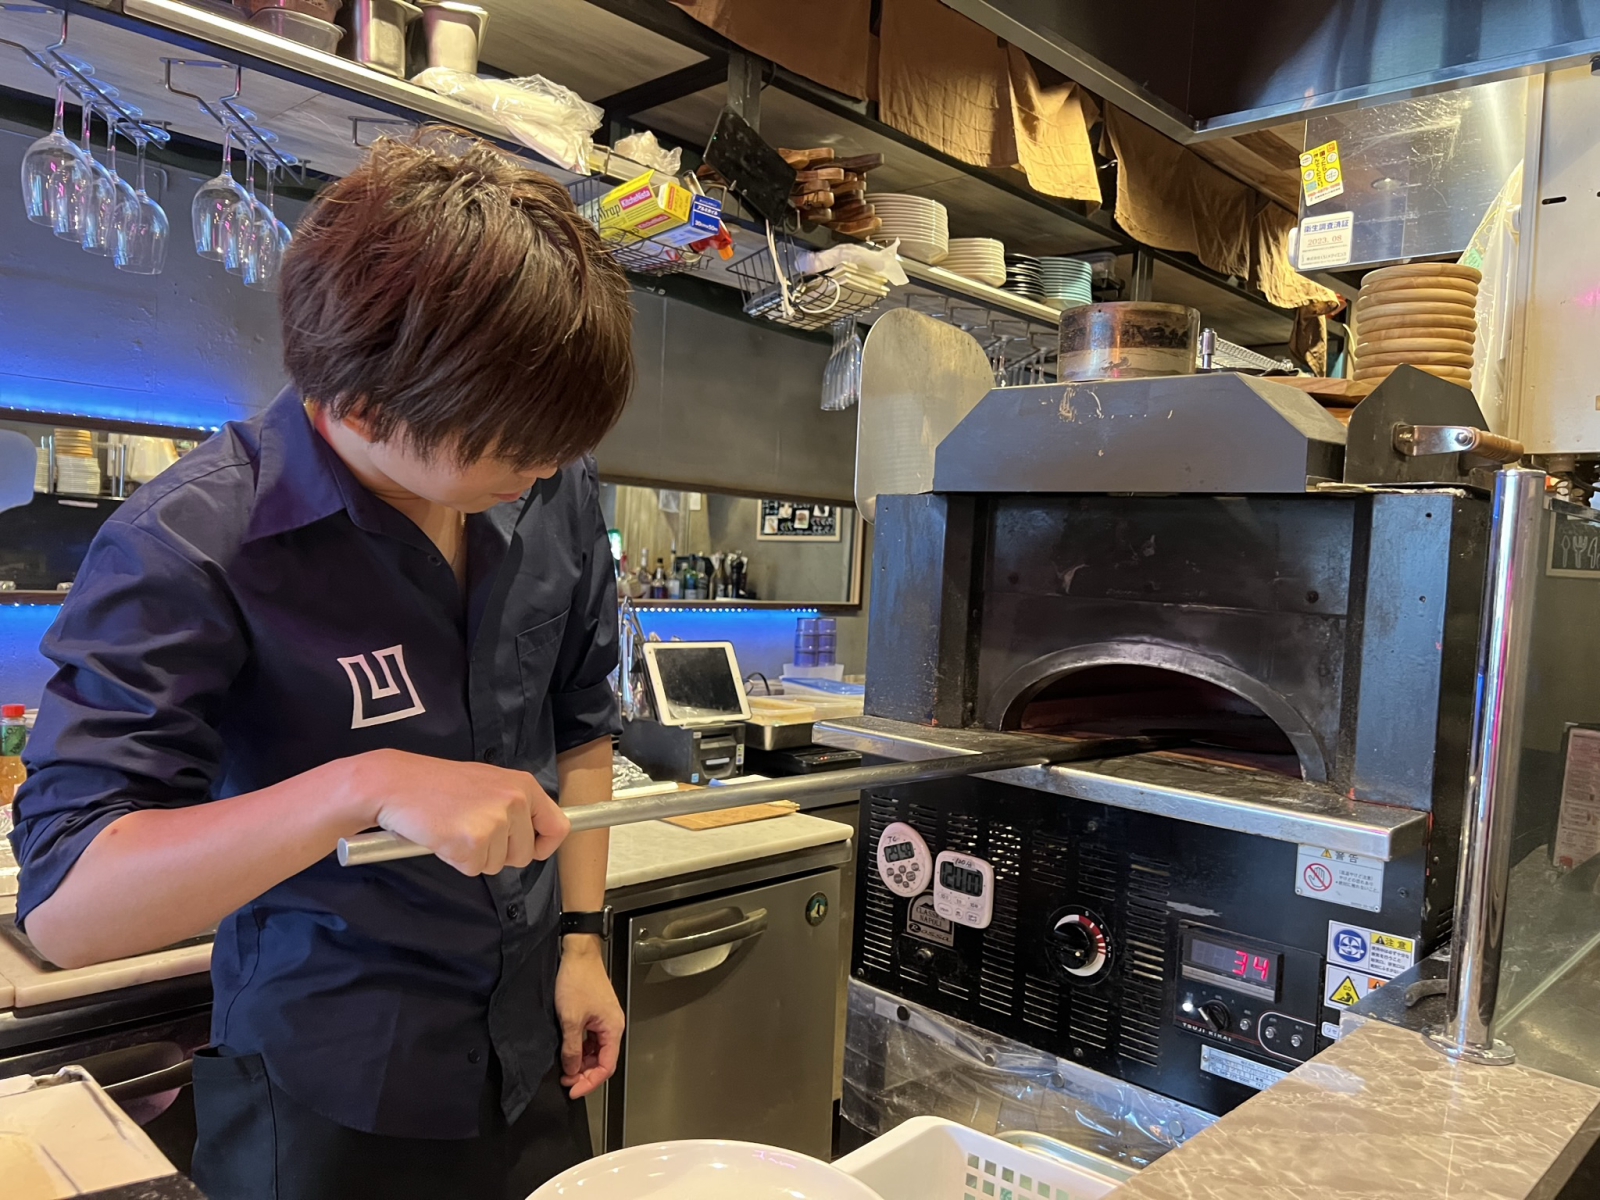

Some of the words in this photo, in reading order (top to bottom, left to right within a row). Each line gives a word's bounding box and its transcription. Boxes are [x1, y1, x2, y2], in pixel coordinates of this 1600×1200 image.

[1385, 937, 1407, 950] 注意
[1232, 950, 1270, 981] 34
[1182, 1022, 1206, 1034] TSUJI
[1208, 1030, 1232, 1042] KIKAI
